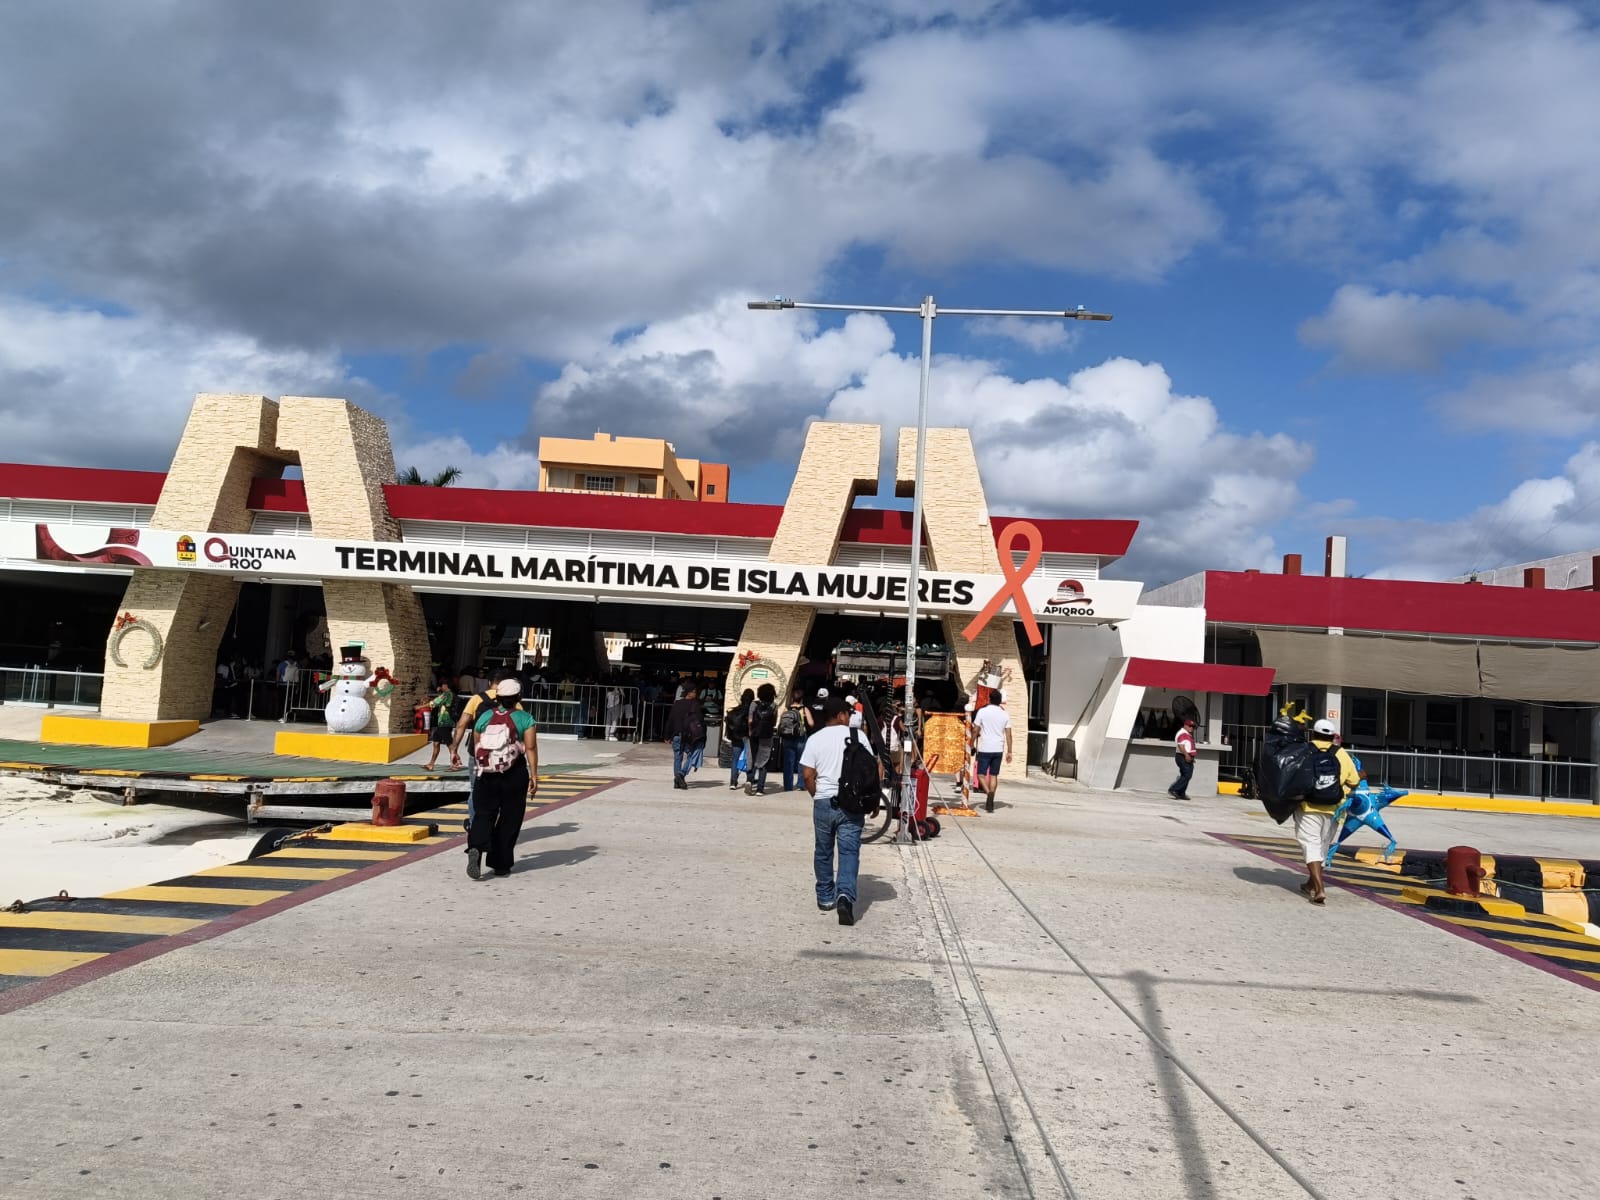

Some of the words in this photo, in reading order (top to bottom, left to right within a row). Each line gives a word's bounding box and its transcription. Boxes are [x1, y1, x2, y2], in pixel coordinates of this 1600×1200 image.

[204, 537, 296, 562] QUINTANA
[230, 558, 263, 570] ROO
[334, 547, 504, 577] TERMINAL
[511, 555, 681, 589] MARÍTIMA
[688, 566, 731, 592] DE
[737, 569, 810, 596] ISLA
[818, 573, 974, 606] MUJERES
[1043, 606, 1094, 616] APIQROO
